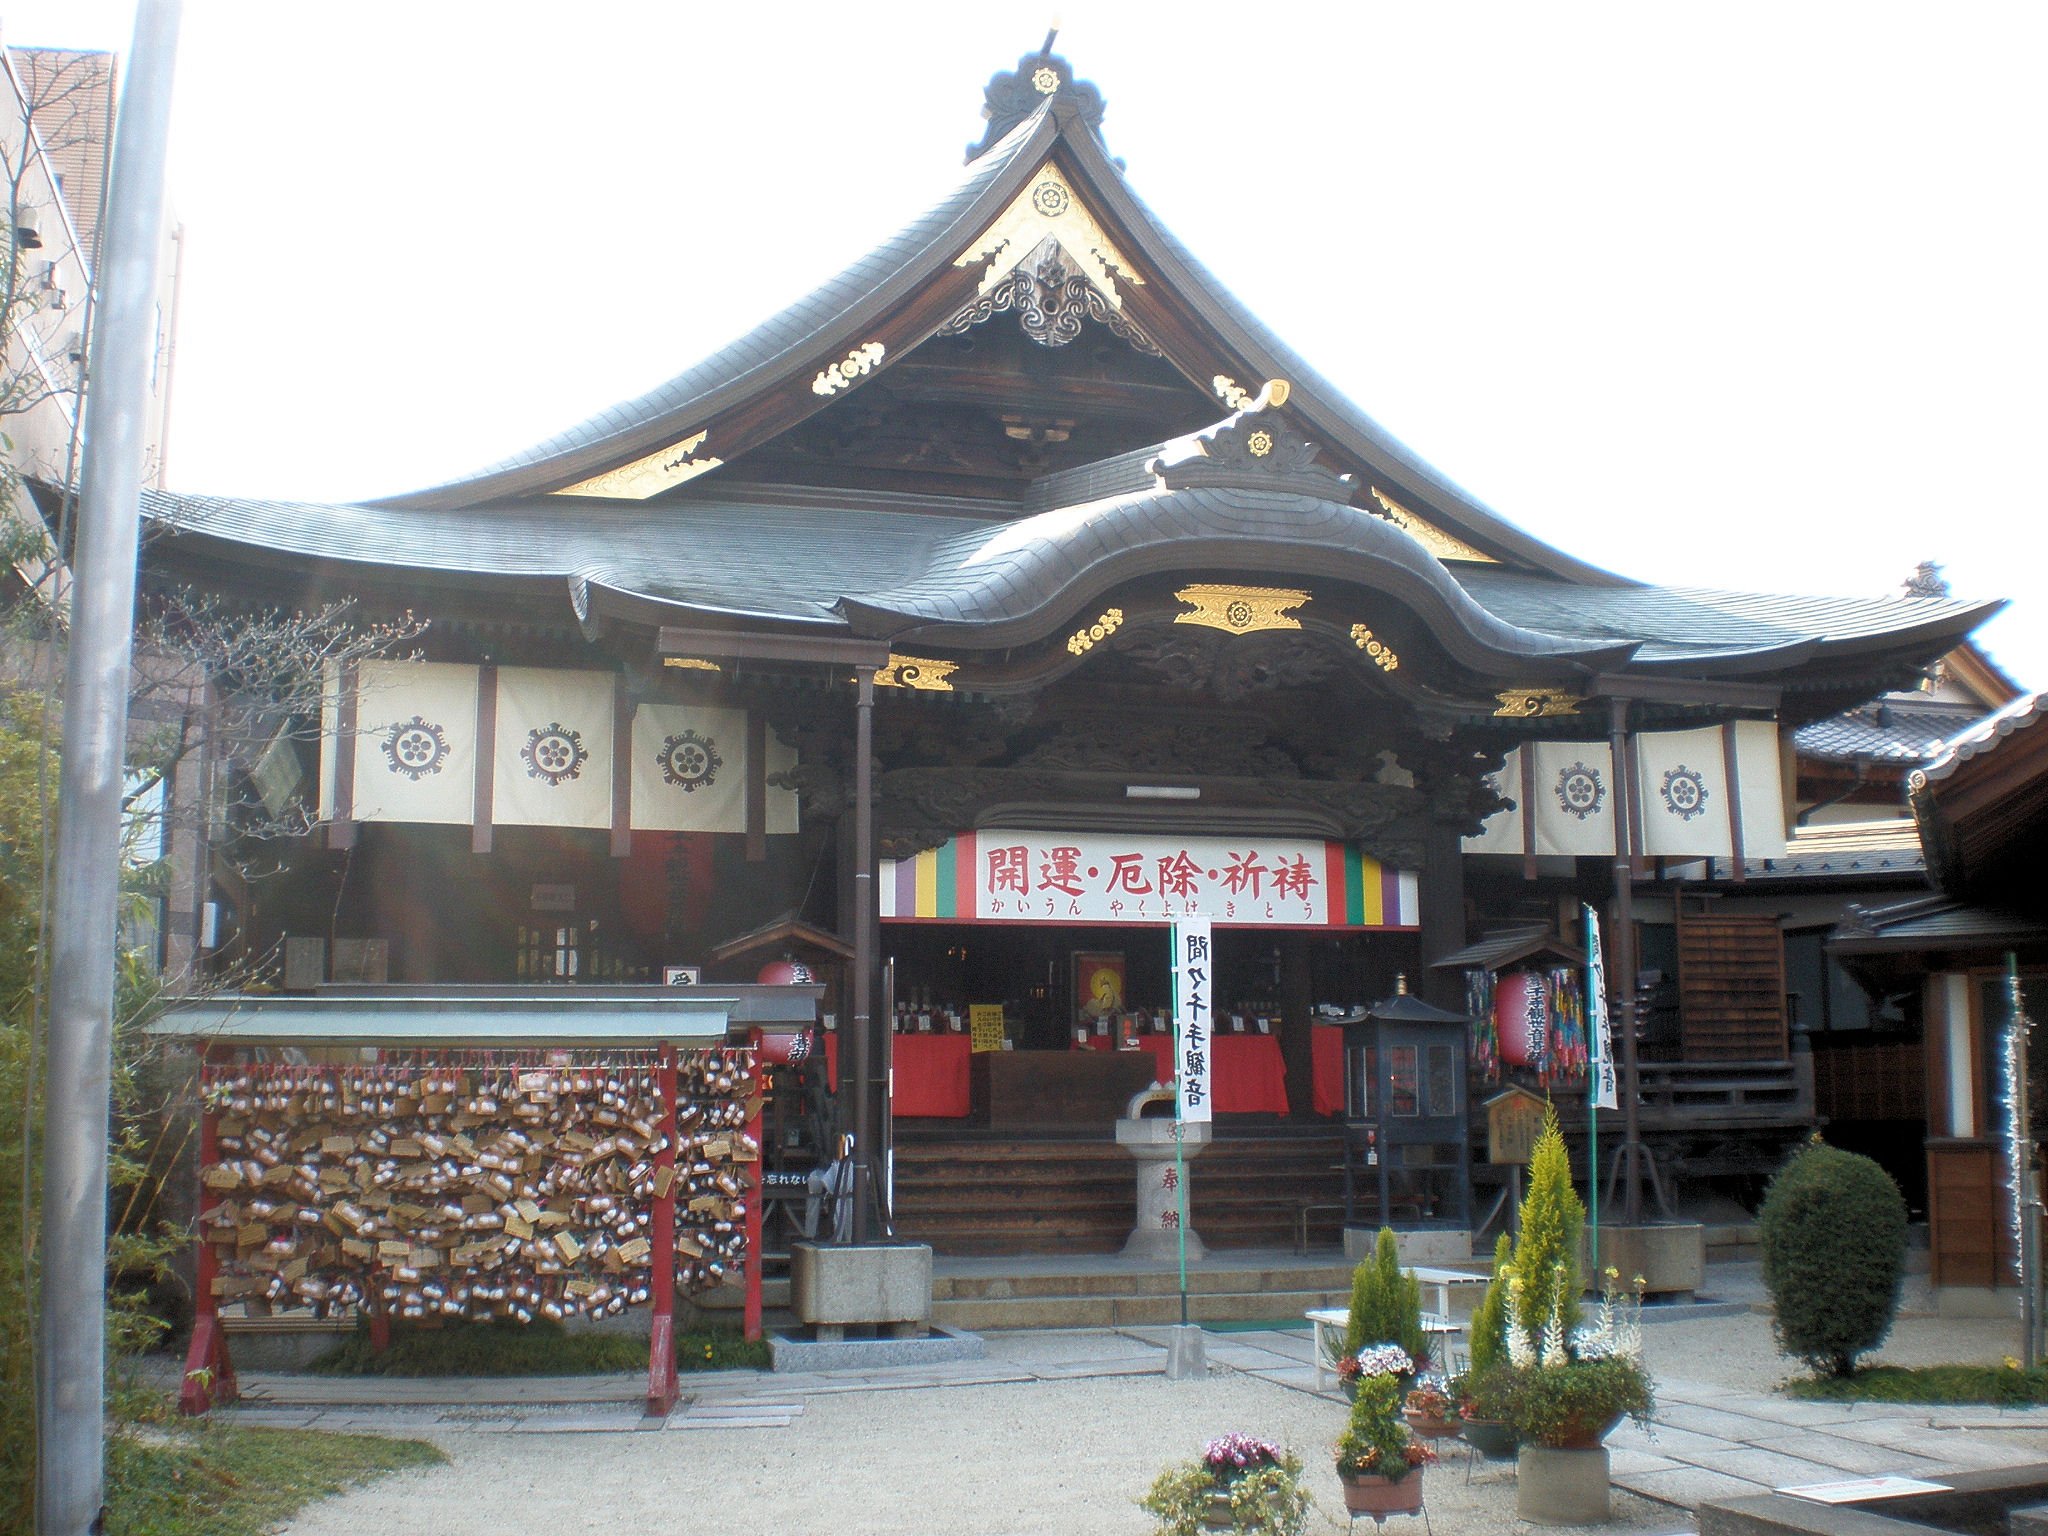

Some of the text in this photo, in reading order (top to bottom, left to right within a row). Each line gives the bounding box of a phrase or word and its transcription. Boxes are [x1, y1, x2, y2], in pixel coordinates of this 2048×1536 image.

[987, 845, 1318, 900] 開運・厄除・祈祷
[991, 898, 1314, 919] かいうん やくよけ きとう
[1161, 1167, 1180, 1229] 奉納
